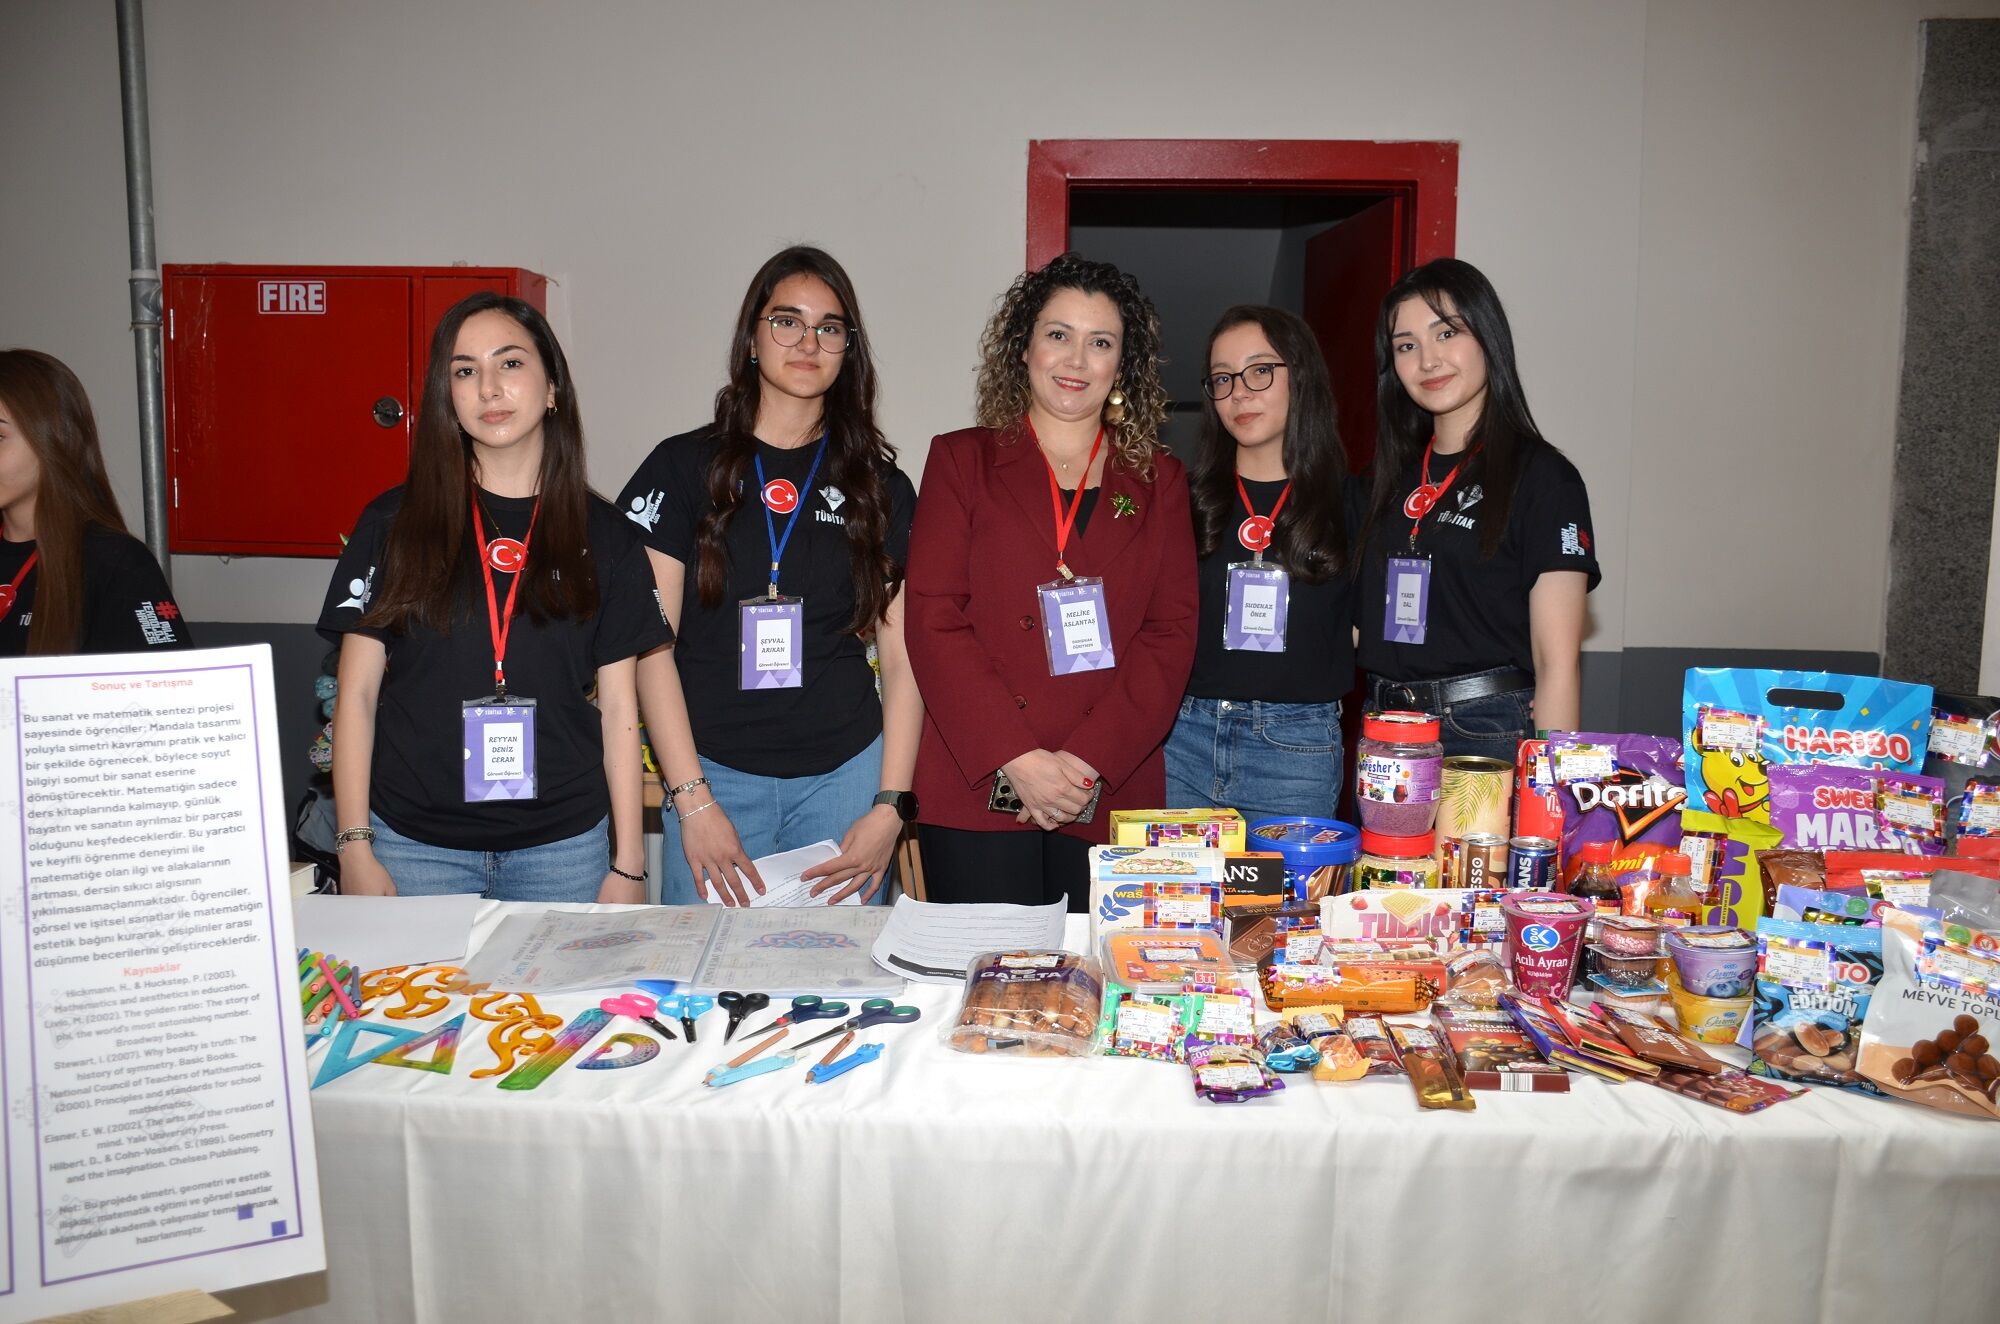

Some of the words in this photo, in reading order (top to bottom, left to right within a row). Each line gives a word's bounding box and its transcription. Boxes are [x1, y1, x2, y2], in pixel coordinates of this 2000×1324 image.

[263, 284, 323, 311] FIRE
[815, 509, 846, 526] TÜBİTA
[1063, 618, 1096, 628] ASLANTAŞ
[1066, 609, 1090, 619] MELİKE
[761, 646, 785, 654] ARIKAN
[22, 713, 38, 722] Bu
[41, 713, 74, 722] sanat
[92, 708, 152, 719] matematik
[155, 707, 195, 716] sentezi
[198, 703, 233, 714] projesi
[24, 728, 82, 740] sayesinde
[149, 721, 194, 731] Mandala
[24, 744, 65, 756] yoluyla
[68, 741, 109, 752] simetri
[168, 736, 200, 747] pratik
[491, 745, 514, 753] DENİZ
[1784, 725, 1911, 763] HARIBO
[25, 762, 40, 770] bir
[155, 752, 198, 762] böylece
[200, 749, 230, 759] soyut
[26, 776, 60, 787] bilgiyi
[63, 774, 100, 784] somut
[102, 772, 117, 781] bir
[120, 770, 151, 780] sanat
[154, 768, 195, 777] eserine
[198, 780, 237, 789] sadece
[1572, 781, 1688, 812] Dorito
[1814, 785, 1874, 810] SWEE
[27, 809, 54, 818] ders
[184, 795, 220, 808] günlük
[185, 814, 199, 822] bir
[188, 828, 202, 837] Bu
[46, 855, 81, 867] keyifli
[138, 846, 189, 858] deneyimi
[192, 844, 204, 853] ile
[1171, 851, 1200, 859] FIBRE
[104, 868, 129, 877] olan
[132, 865, 148, 876] ilgi
[1222, 865, 1259, 882] AN'S
[1470, 857, 1484, 888] ESSO
[1518, 856, 1533, 889] ANS
[83, 884, 120, 895] dersin
[1114, 889, 1143, 899] was
[32, 921, 70, 936] görsel
[127, 912, 175, 924] sanatlar
[177, 909, 190, 918] ile
[32, 938, 75, 950] estetik
[167, 923, 222, 936] disiplinler
[92, 945, 159, 960] becerilerini
[1515, 952, 1534, 967] Acılı
[1537, 956, 1568, 970] Ayran
[123, 962, 181, 976] Kaynaklar
[980, 971, 1062, 980] GALETA
[1788, 994, 1858, 1018] EDITION
[1902, 989, 1955, 1009] MEYVE
[1962, 1000, 2000, 1021] TOPL
